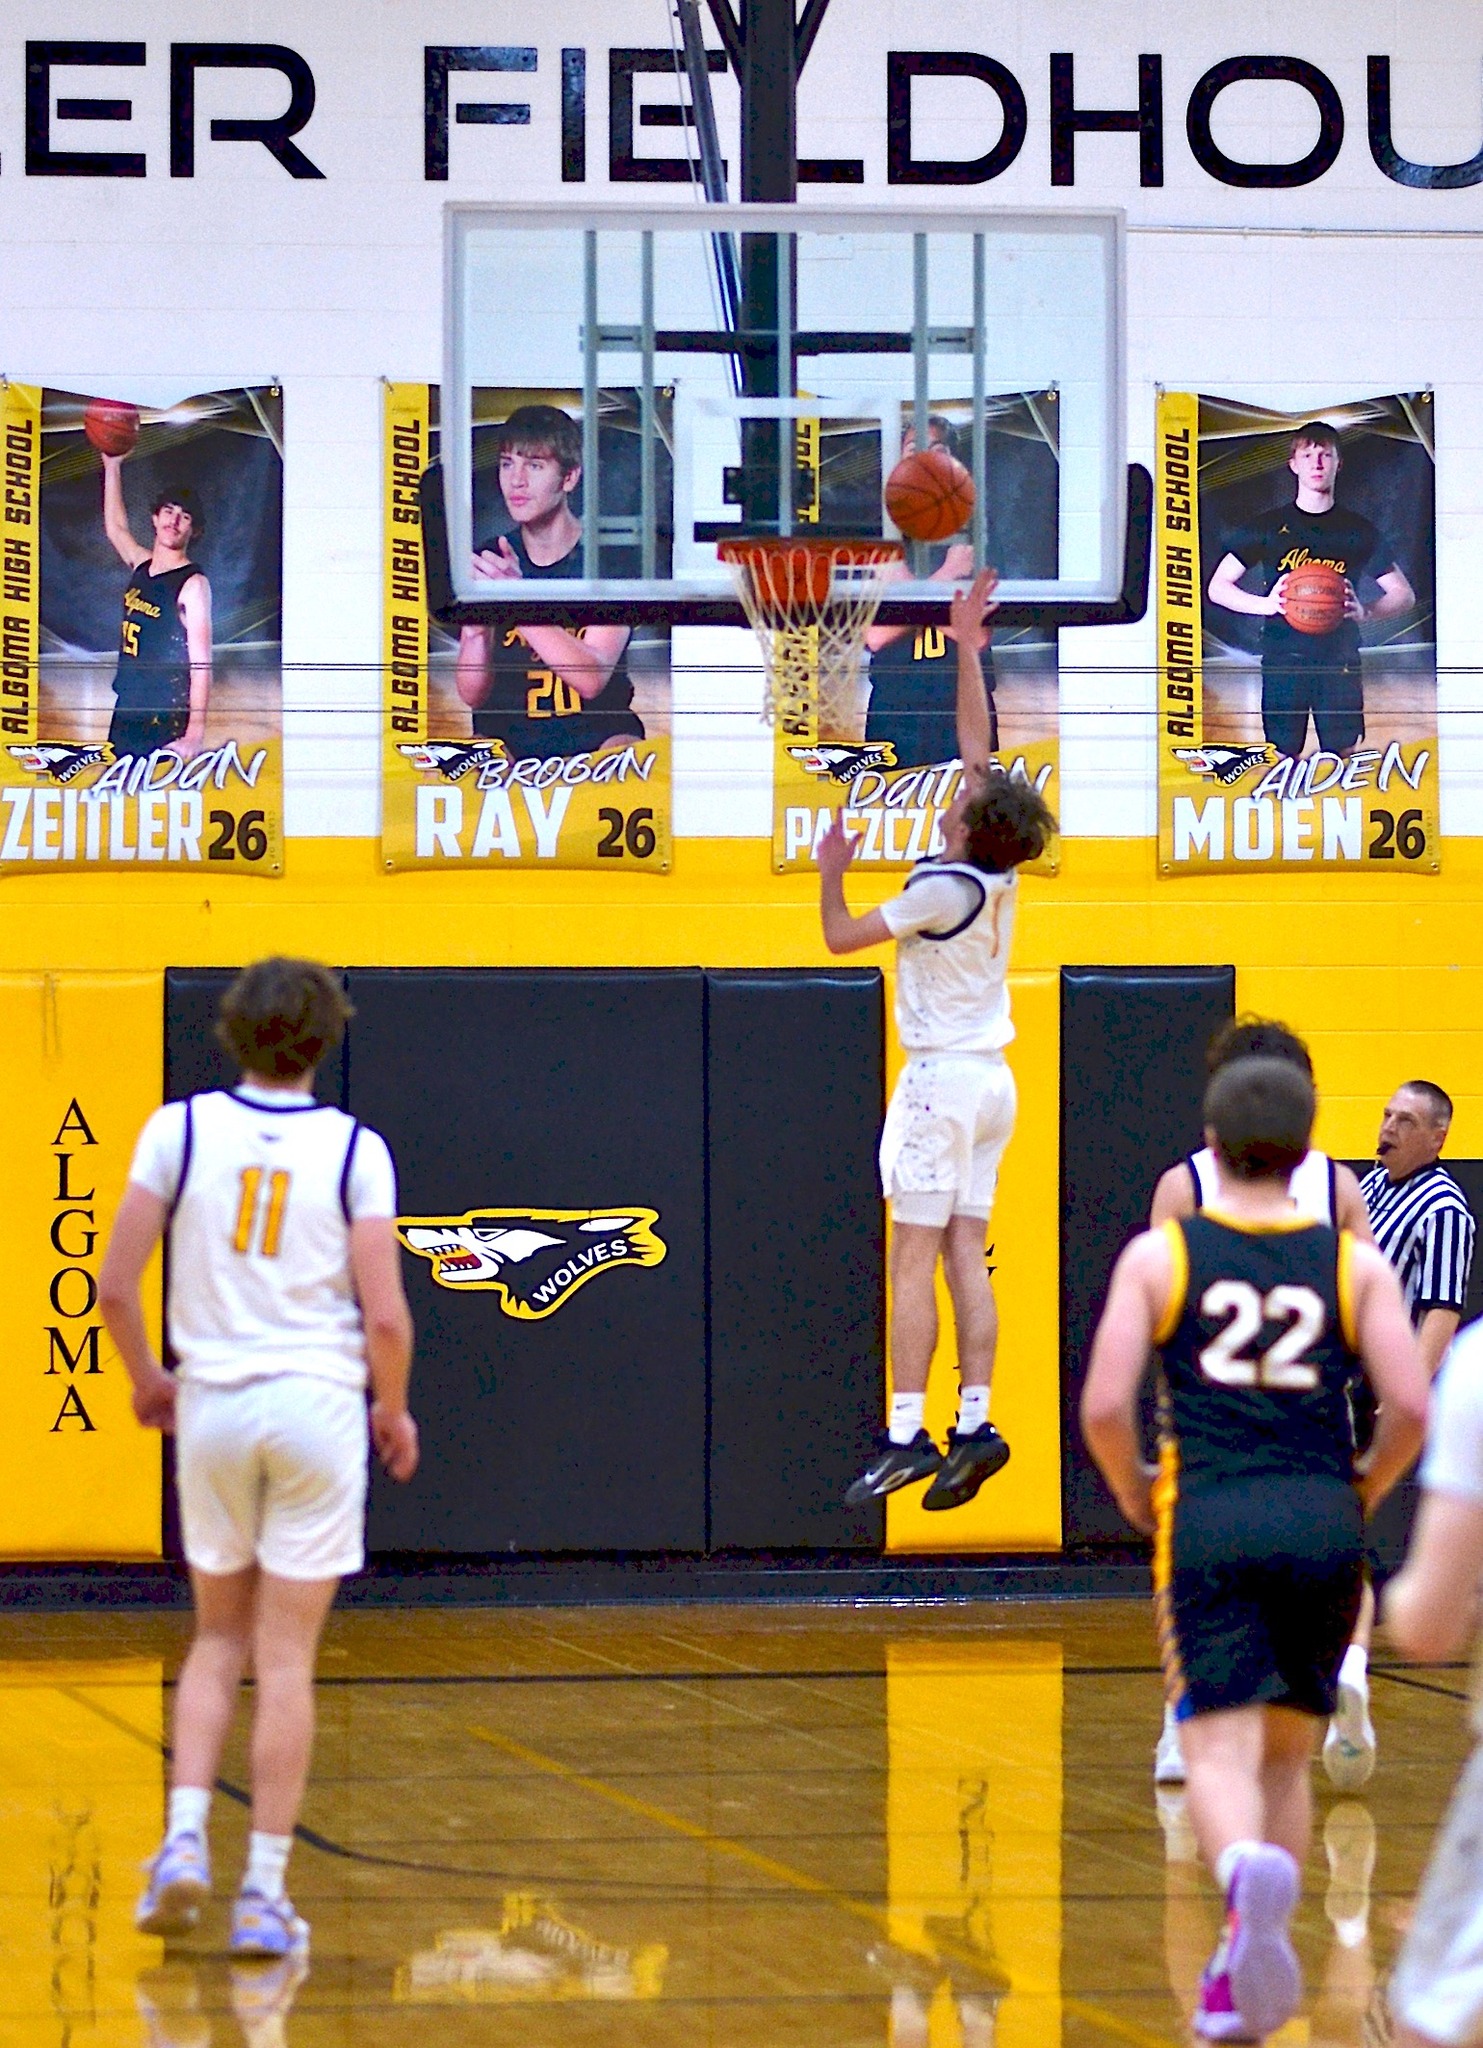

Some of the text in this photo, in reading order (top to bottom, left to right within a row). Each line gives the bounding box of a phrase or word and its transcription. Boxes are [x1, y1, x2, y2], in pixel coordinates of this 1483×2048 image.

[0, 41, 327, 179] ER
[5, 418, 33, 526] SCHOOL
[392, 418, 420, 525] SCHOOL
[1165, 427, 1191, 532] SCHOOL
[4, 537, 31, 603] HIGH
[392, 537, 420, 602] HIGH
[1166, 545, 1193, 608] HIGH
[1, 614, 30, 735] ALGOMA
[391, 614, 419, 734] ALGOMA
[913, 626, 946, 660] 10
[527, 670, 582, 718] 20
[1166, 620, 1195, 738] ALGOMA
[58, 751, 102, 783] WOLVES
[448, 748, 492, 780] WOLVES
[838, 752, 883, 783] WOLVES
[1223, 753, 1265, 785] WOLVES
[1252, 740, 1430, 801] AIDEN
[0, 788, 203, 861] ZEITLER
[208, 810, 268, 862] 26
[415, 785, 574, 858] RAY
[597, 807, 656, 858] 26
[1172, 797, 1362, 861] MOEN
[1368, 809, 1426, 860] 26
[232, 1166, 292, 1260] 11
[43, 1097, 104, 1433] ALGOMA
[532, 1238, 629, 1304] WOLVES
[1198, 1279, 1328, 1390] 22
